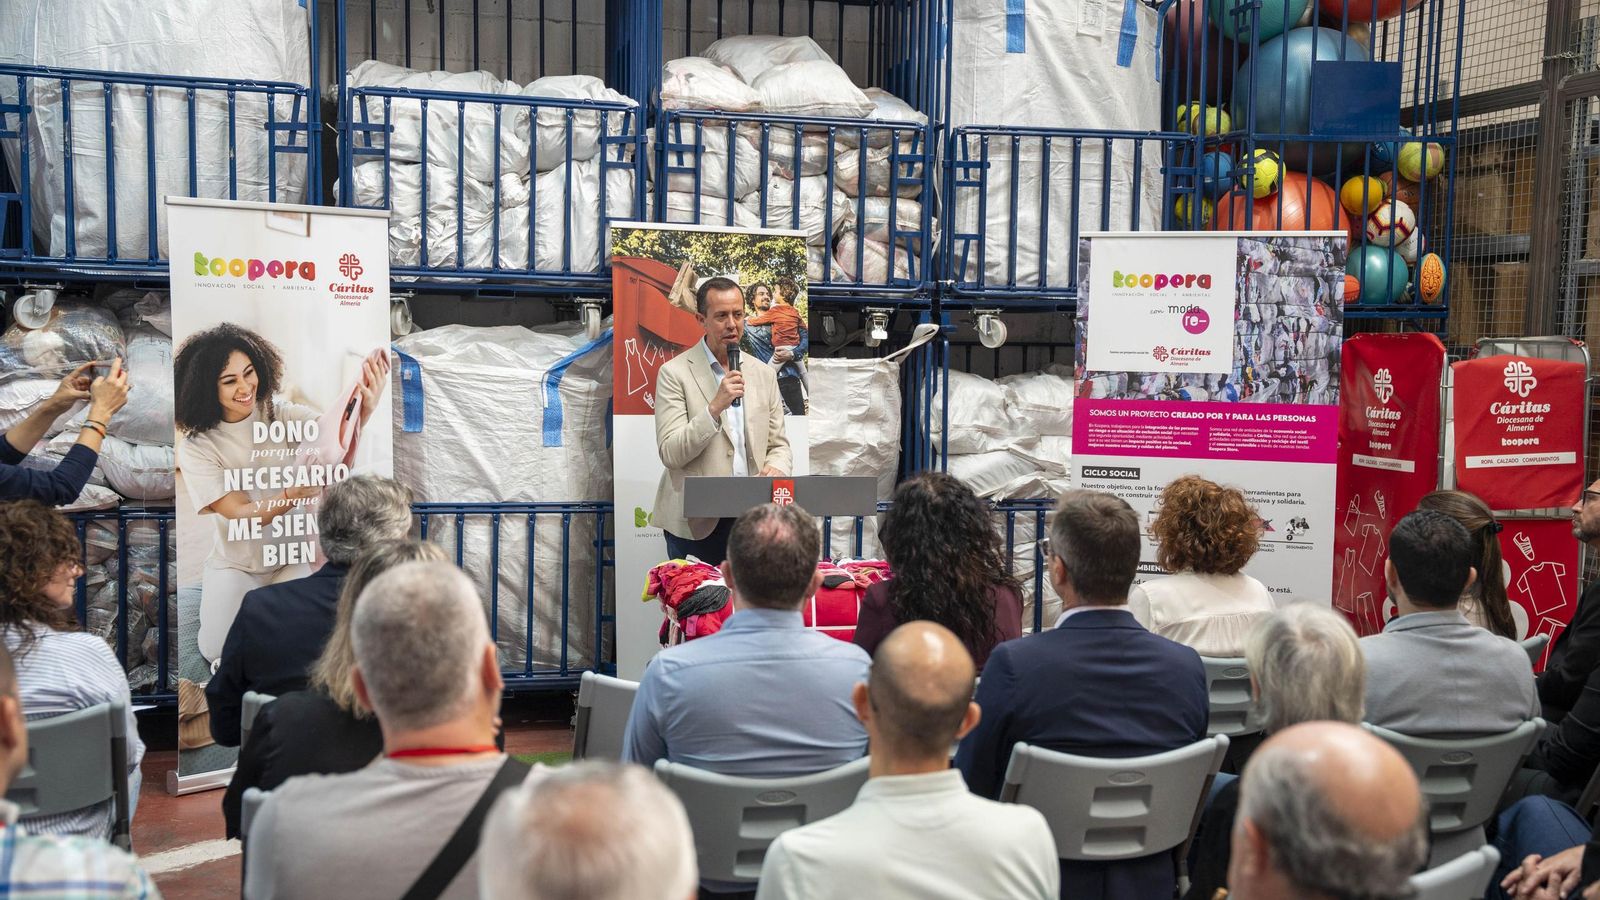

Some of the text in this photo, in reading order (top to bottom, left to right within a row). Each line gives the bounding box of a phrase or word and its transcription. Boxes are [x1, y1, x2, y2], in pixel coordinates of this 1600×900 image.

[194, 251, 316, 282] koopera
[1112, 270, 1212, 290] koopera
[329, 282, 374, 294] Cáritas
[1168, 304, 1200, 314] moda
[1170, 348, 1211, 356] Cáritas
[1366, 406, 1402, 420] Cáritas
[1490, 401, 1550, 414] Cáritas
[1368, 420, 1389, 428] Diocesana
[1496, 416, 1534, 424] Diocesana
[253, 419, 319, 444] DONO
[1506, 424, 1534, 432] Almería
[1502, 437, 1539, 446] koopera
[250, 446, 320, 462] porque es
[224, 463, 350, 492] NECESARIO
[254, 496, 320, 512] y porque
[228, 514, 319, 541] ME SIEN
[263, 541, 316, 567] BIEN
